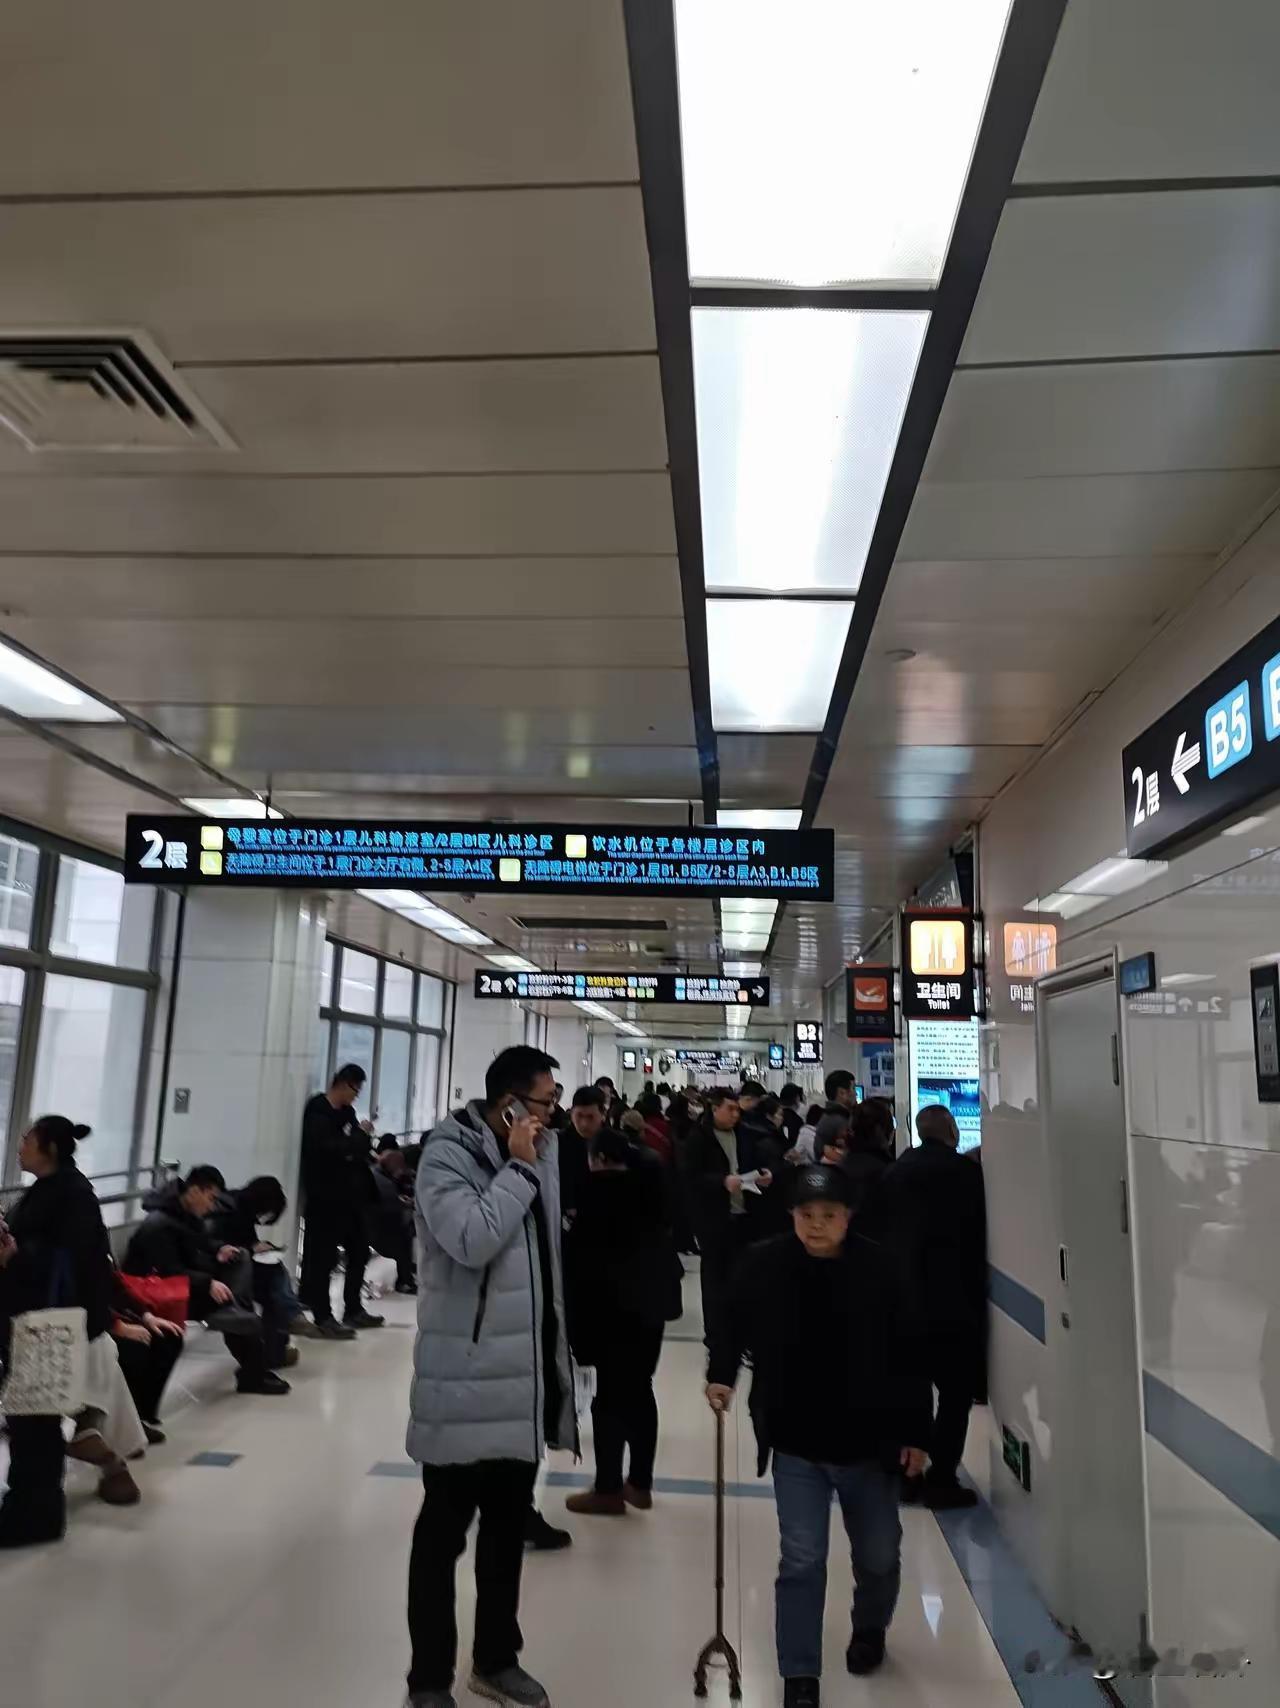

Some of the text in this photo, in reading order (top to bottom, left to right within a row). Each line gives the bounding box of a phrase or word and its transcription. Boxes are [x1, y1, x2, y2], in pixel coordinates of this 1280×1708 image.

[1131, 766, 1160, 828] 2层
[1210, 694, 1247, 768] B5
[138, 829, 188, 869] 2层
[592, 834, 765, 855] 饮水机位于各楼层诊区内
[916, 982, 961, 1000] 卫生间
[927, 999, 950, 1010] Toilet
